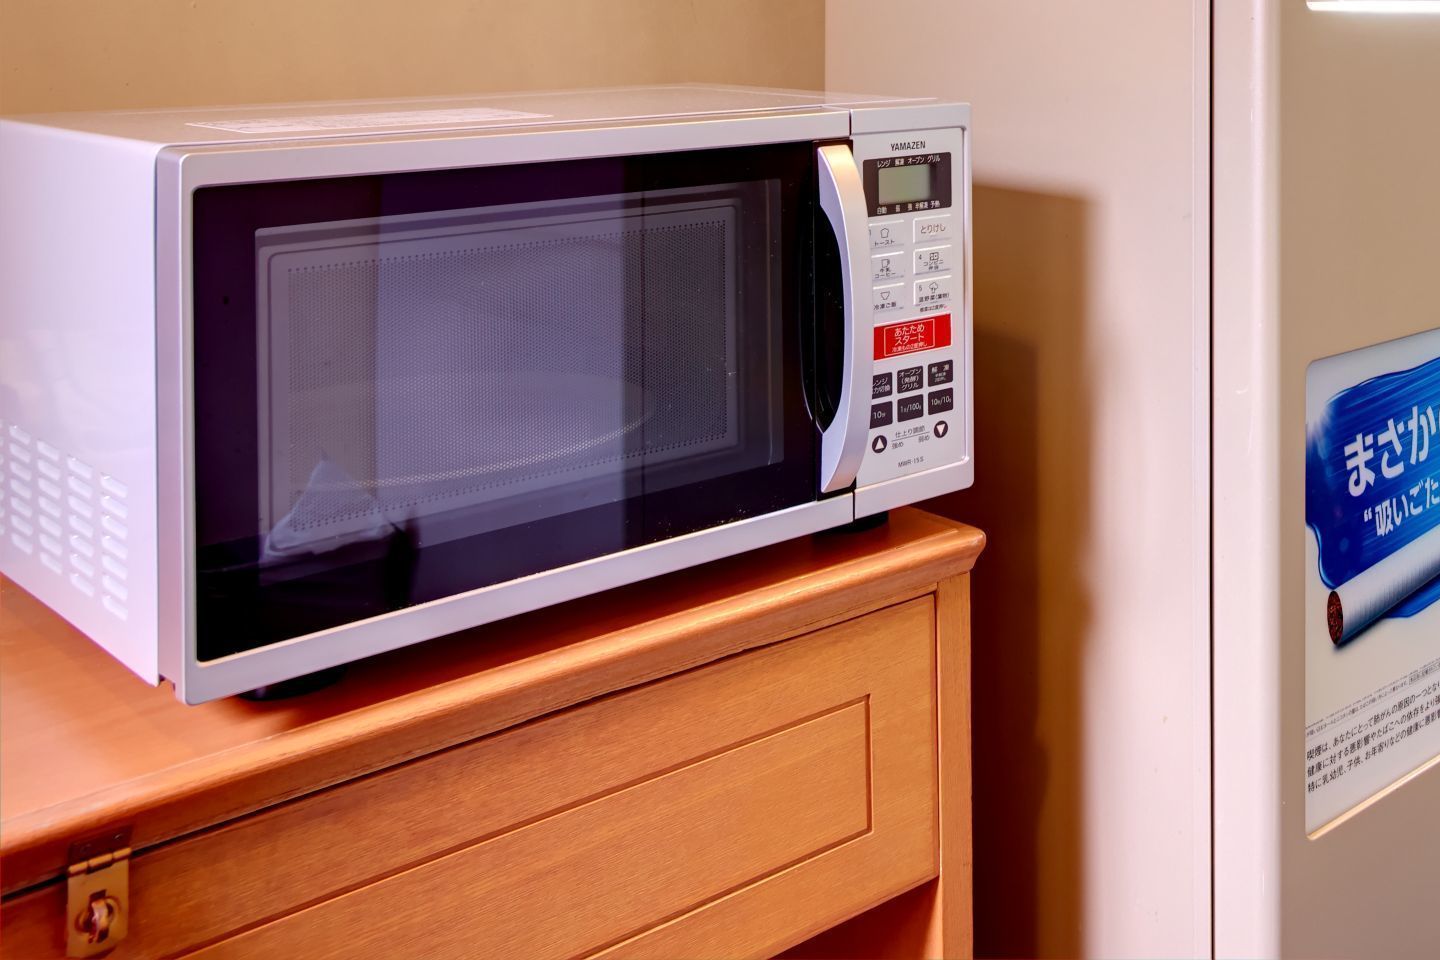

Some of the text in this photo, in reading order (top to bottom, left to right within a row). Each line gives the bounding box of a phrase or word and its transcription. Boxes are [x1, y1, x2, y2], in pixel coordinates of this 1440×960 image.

[890, 141, 926, 151] YAMAZEN
[877, 159, 891, 168] レンジ
[920, 224, 946, 234] とりけし
[923, 259, 944, 267] コンビニ
[894, 323, 925, 337] あたため
[894, 332, 925, 346] スタート
[901, 382, 919, 391] グリル
